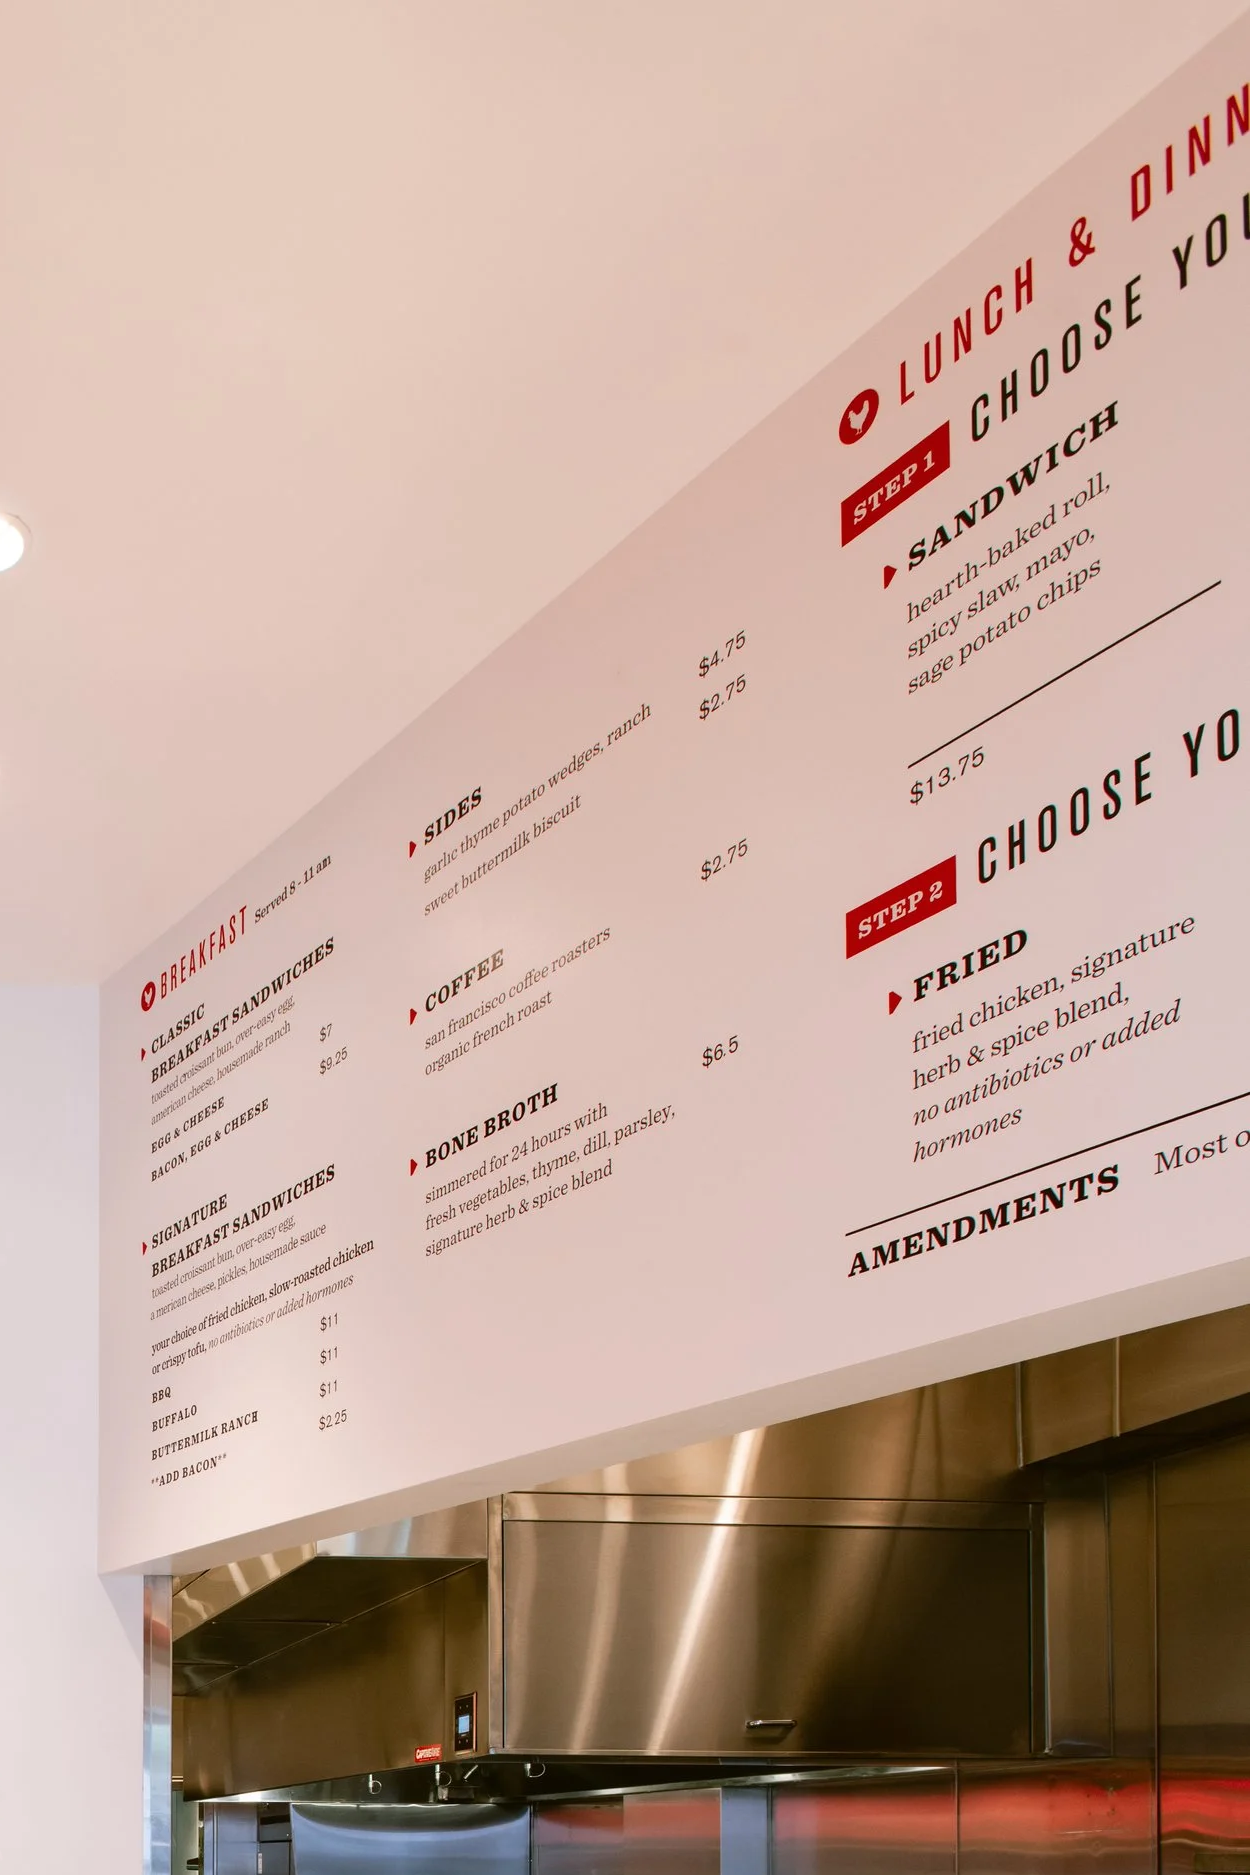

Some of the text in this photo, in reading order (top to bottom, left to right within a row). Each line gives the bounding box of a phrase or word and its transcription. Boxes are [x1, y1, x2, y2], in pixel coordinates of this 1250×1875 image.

[900, 83, 1250, 406] LUNCH & DINN
[971, 274, 1142, 443] CHOOSE
[853, 451, 935, 525] STEP 1
[907, 400, 1119, 571] SANDWICH
[906, 472, 1110, 623] hearth-baked roll,
[907, 528, 1095, 658] spicy slaw, mayo,
[908, 560, 1101, 694] sage potato chips
[698, 629, 746, 677] $4.75
[698, 673, 747, 719] $2.75
[424, 705, 652, 884] garlic thyme potato wedges, ranch
[424, 788, 482, 845] SIDES
[909, 747, 985, 805] $13.75
[978, 751, 1152, 884] CHOOSE
[424, 795, 582, 916] sweet buttermilk biscuit
[700, 838, 748, 880] $2.75
[160, 855, 332, 999] BREAKFAST Served 8 11 am
[858, 880, 943, 940] STEP 2
[424, 927, 611, 1049] san francisco coffee roasters
[425, 949, 504, 1012] COFFEE
[912, 917, 1195, 1053] fried chicken, signature
[913, 929, 1028, 1003] FRIED
[151, 937, 334, 1083] BREAKFAST SANDWICHES
[151, 1004, 205, 1054] CLASSIC
[151, 995, 296, 1104] toasted croissant bun, over-easy egg,
[319, 1024, 333, 1042] $7
[425, 991, 553, 1075] organic french roast
[702, 1034, 739, 1068] $6.5
[912, 982, 1130, 1089] herb & spice blend,
[150, 1022, 291, 1125] american cheese, housemade ranch
[319, 1046, 348, 1074] $9.25
[913, 1000, 1181, 1126] no antibiotics or added
[151, 1096, 225, 1153] EGG & CHEESE
[151, 1098, 269, 1182] BACON, EGG & CHEESE
[425, 1084, 558, 1168] BONE BROTH
[425, 1105, 608, 1203] simmered for 24 hours with
[913, 1108, 1023, 1162] hormones
[425, 1104, 675, 1230] fresh vegetables, thyme, dill, parsley,
[425, 1160, 613, 1256] signature herb & spice blend
[848, 1165, 1120, 1278] AMENDMENTS
[1154, 1134, 1228, 1175] Most
[151, 1164, 335, 1277] BREAKFAST SANDWICHES
[151, 1194, 228, 1249] SIGNATURE
[151, 1215, 297, 1298] toasted croissant bun, over-easy egg,
[187, 1224, 327, 1301] cheese, pickles, housemade sauce
[151, 1239, 375, 1356] your choice of fried chicken, slow-roasted chicken
[151, 1274, 354, 1374] or crispy tofu, no antibiotics or added hormones
[319, 1312, 338, 1332] $11
[151, 1386, 172, 1403] BBQ
[319, 1345, 338, 1365] $11
[319, 1379, 338, 1398] $11
[151, 1404, 198, 1432] BUFFALO
[151, 1410, 259, 1460] BUTTERMILK RANCH
